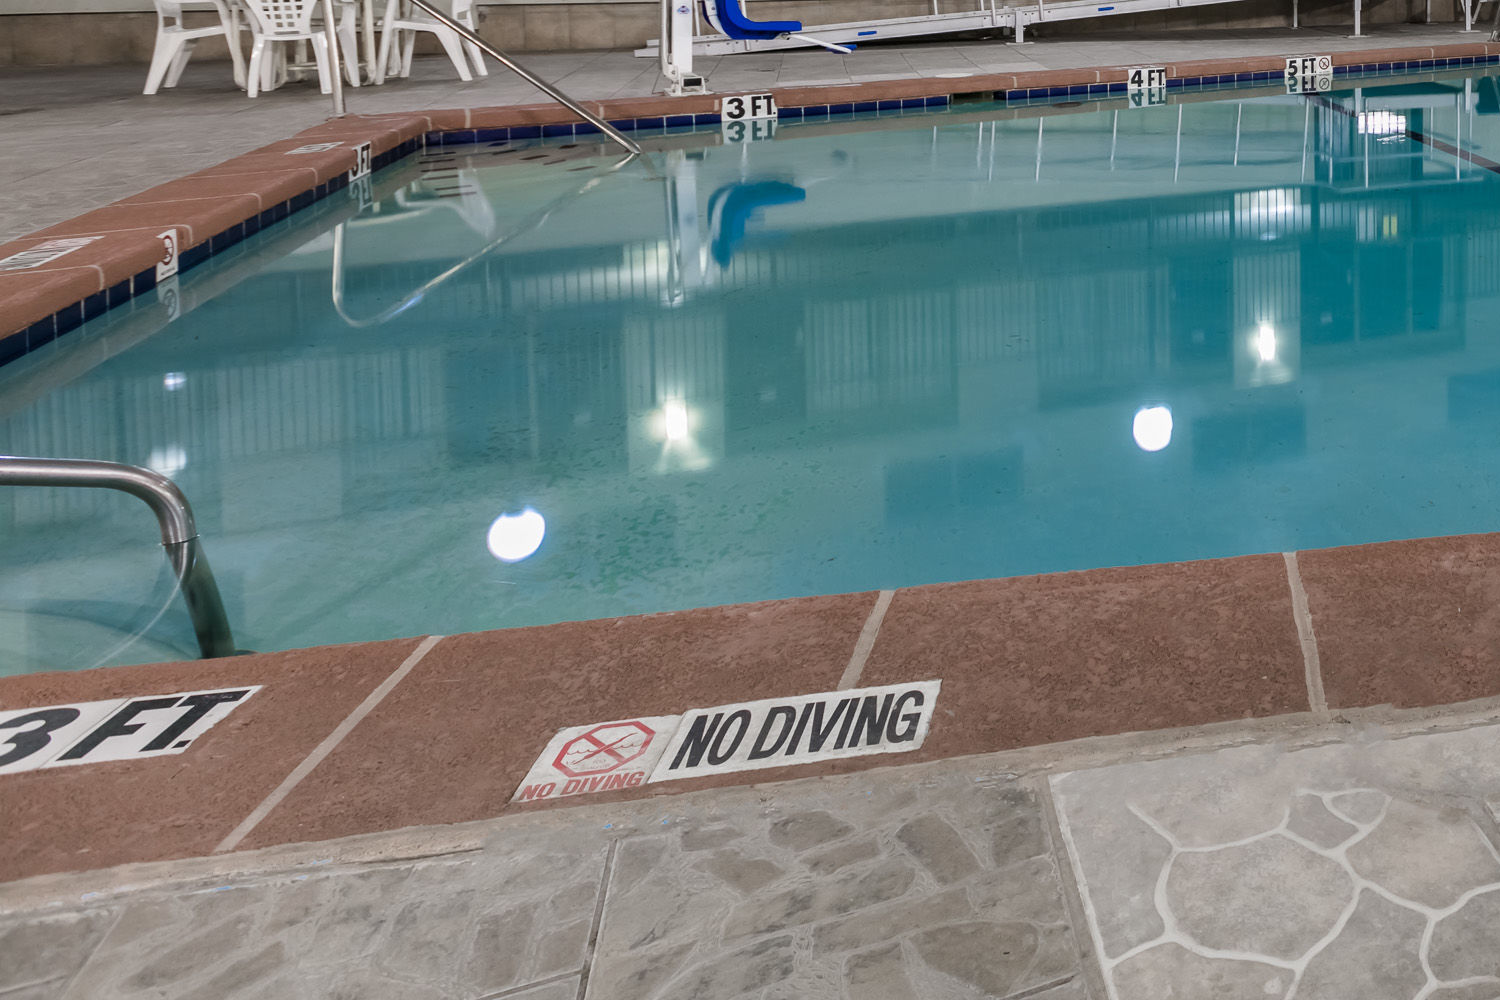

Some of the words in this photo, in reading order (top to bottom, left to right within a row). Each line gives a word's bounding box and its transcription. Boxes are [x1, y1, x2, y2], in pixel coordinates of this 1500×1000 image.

[1130, 70, 1144, 87] 4
[1148, 69, 1165, 86] FT.
[1288, 60, 1298, 76] 5
[727, 98, 746, 119] 3
[751, 95, 776, 117] FT.
[0, 708, 80, 767] 3
[55, 689, 251, 761] FT.
[668, 710, 751, 771] NO
[747, 690, 925, 761] DIVING
[518, 782, 556, 800] NO
[560, 771, 645, 795] DIVING
